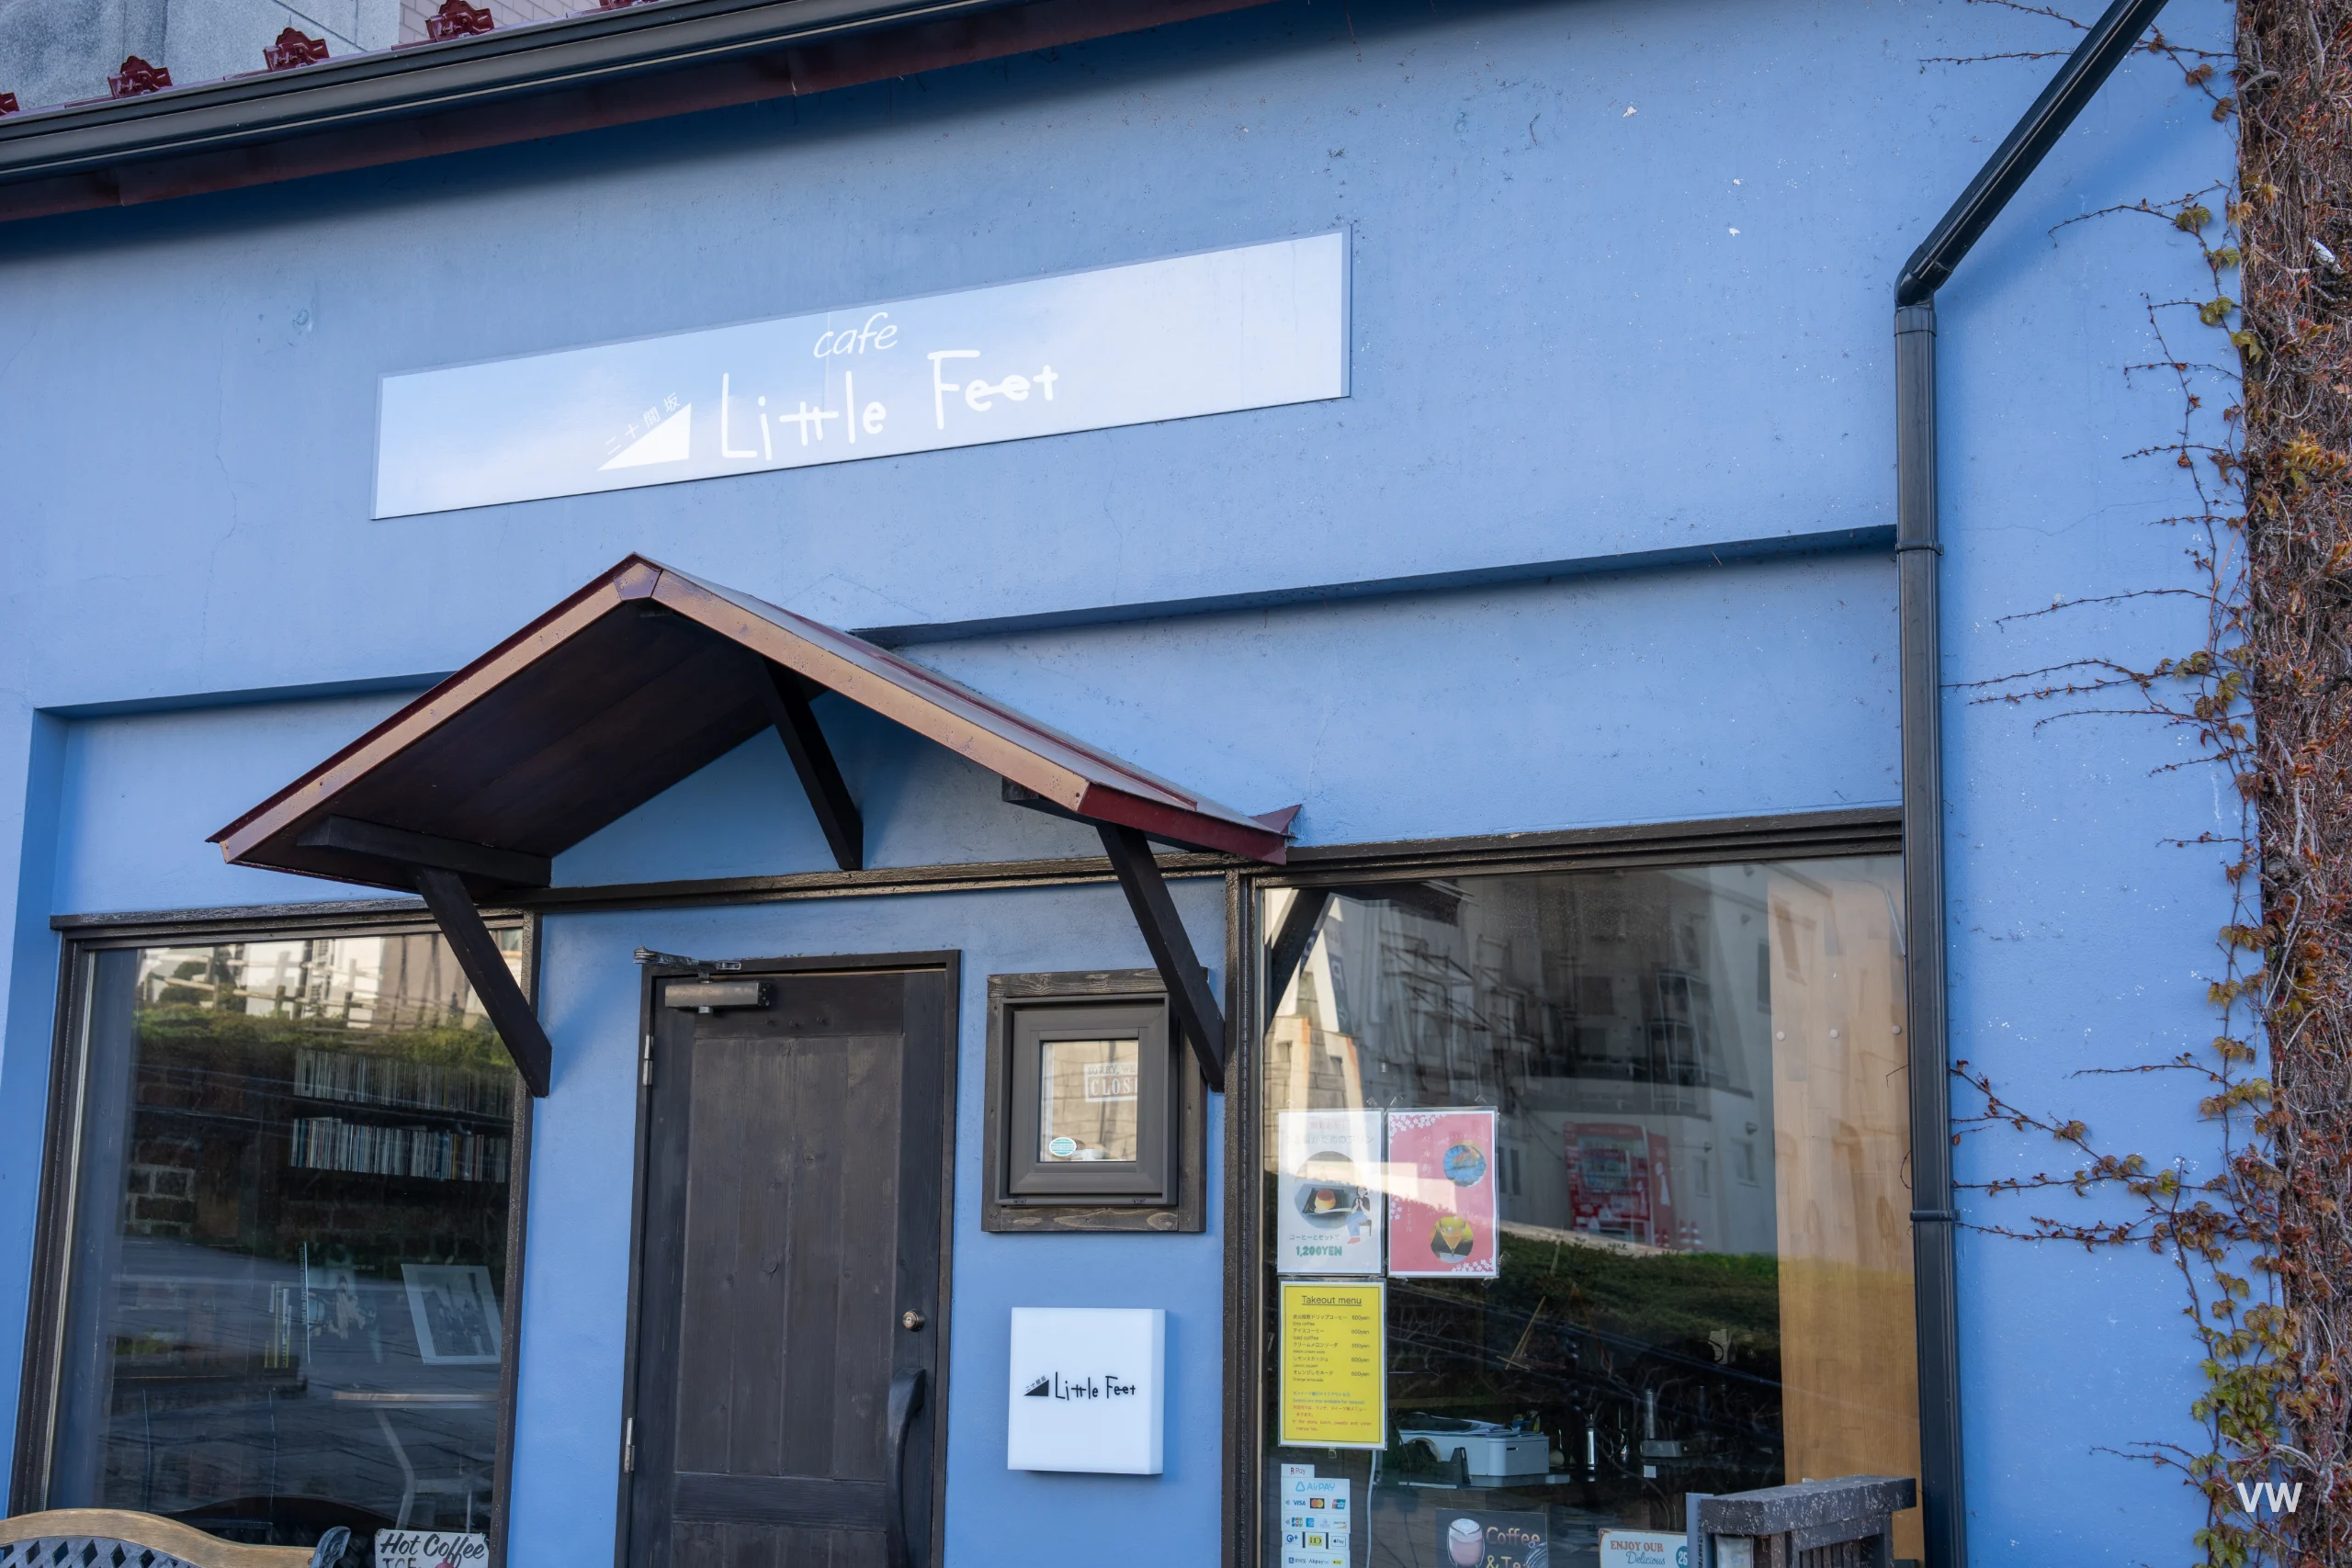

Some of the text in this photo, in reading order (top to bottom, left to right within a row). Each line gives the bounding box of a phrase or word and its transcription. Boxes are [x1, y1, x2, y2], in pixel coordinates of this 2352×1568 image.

[813, 312, 898, 357] cafe
[721, 349, 1058, 460] Little Feet
[605, 392, 680, 455] 二十間坂
[1088, 1066, 1119, 1075] SORRY,
[1296, 1246, 1342, 1257] 1,200YEN
[1302, 1295, 1362, 1305] Takeout menu
[1055, 1371, 1136, 1401] Little Feet
[1486, 1526, 1541, 1545] Coffee
[380, 1532, 485, 1568] Hot Coffee
[1610, 1540, 1664, 1552] ENJOY OUR
[1626, 1551, 1666, 1565] Delicious
